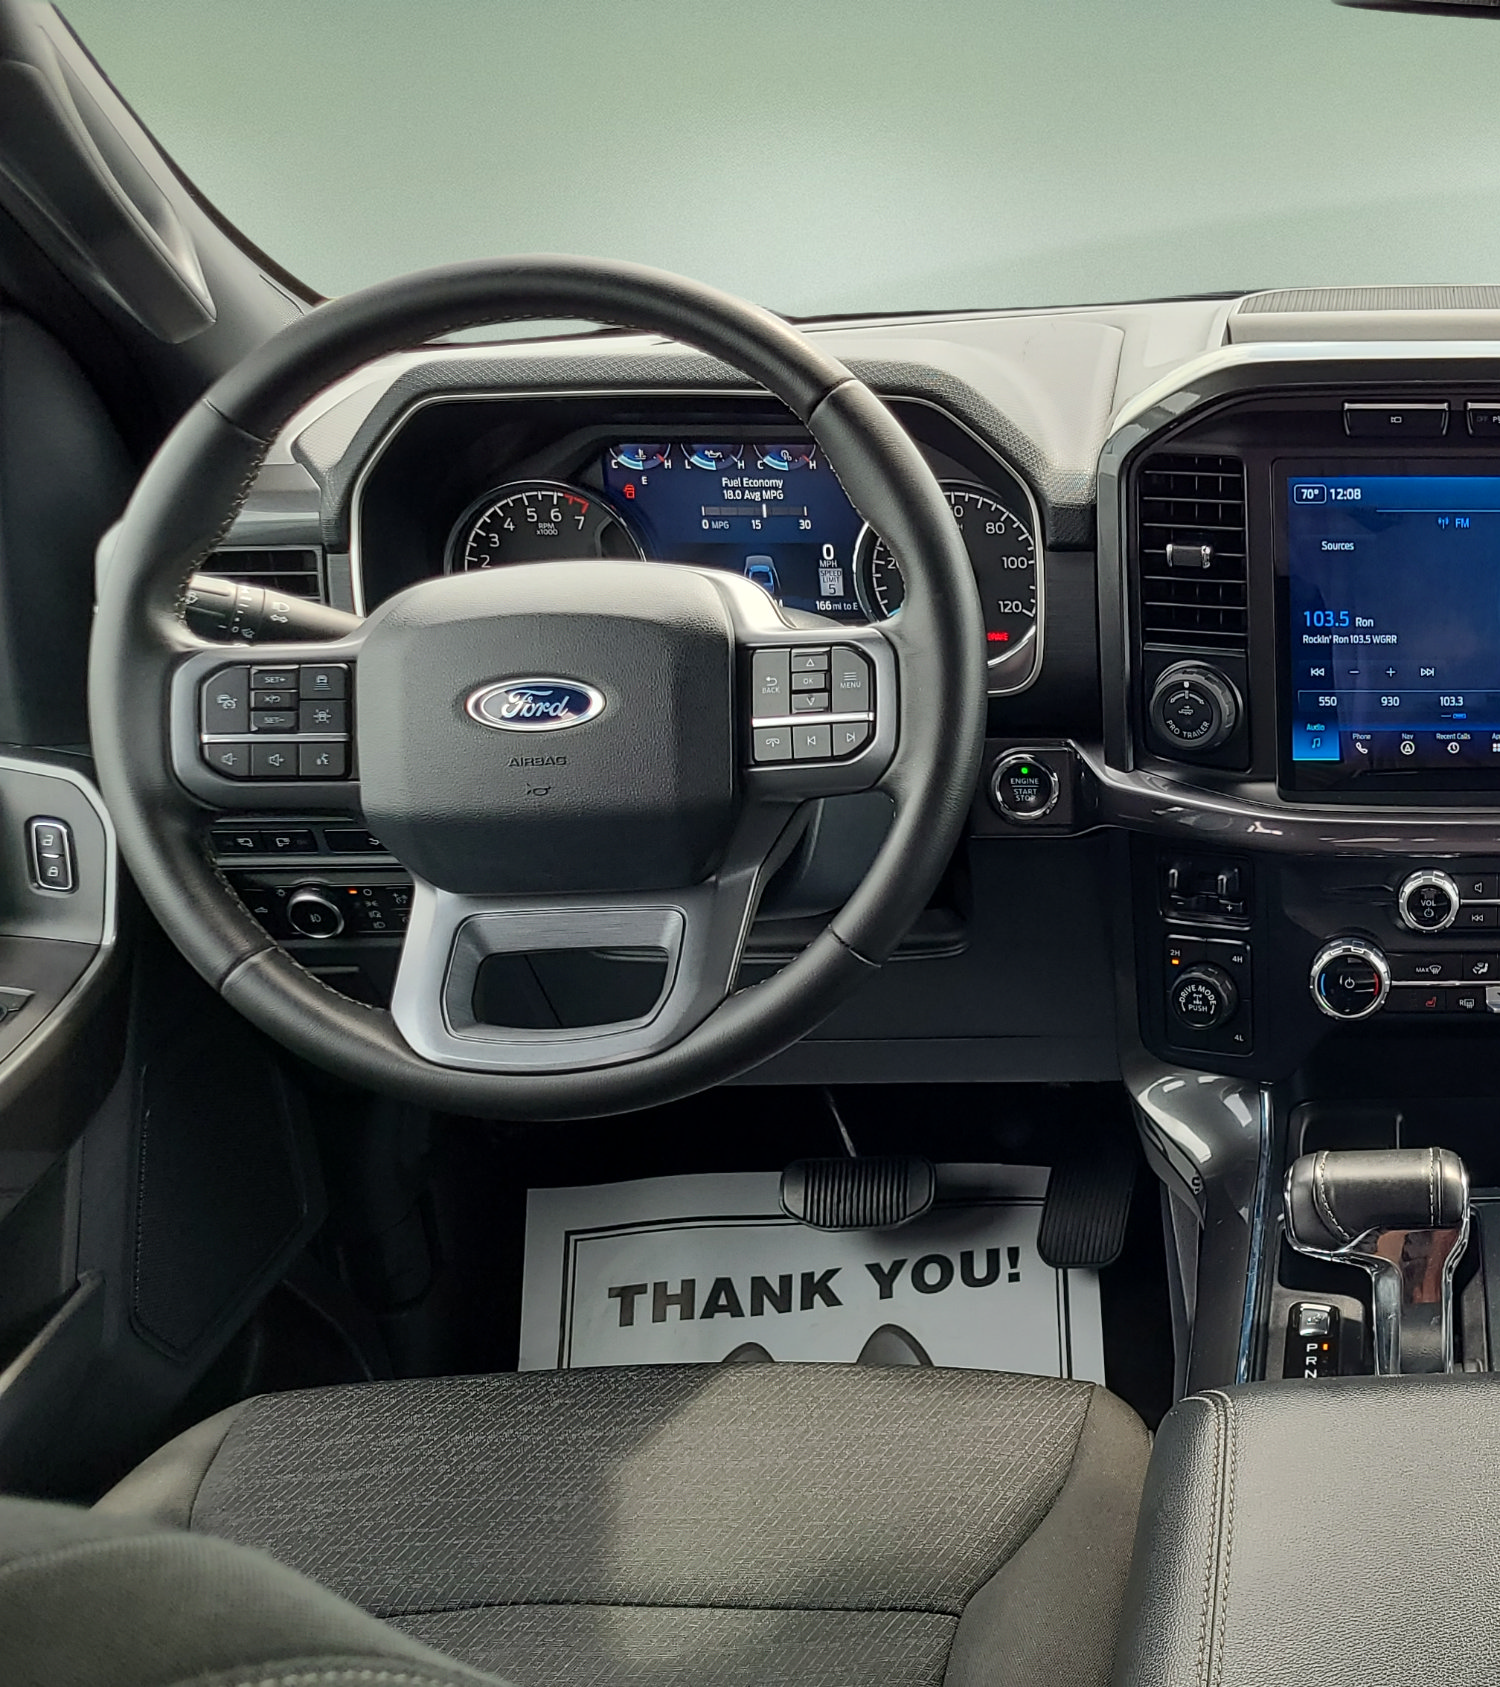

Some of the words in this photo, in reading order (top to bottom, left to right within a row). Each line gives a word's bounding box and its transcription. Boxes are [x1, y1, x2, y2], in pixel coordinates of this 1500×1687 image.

[611, 460, 618, 469] C
[664, 459, 672, 469] H
[685, 459, 691, 469] L
[737, 459, 745, 469] H
[757, 460, 764, 469] C
[809, 459, 817, 469] H
[641, 476, 648, 485] E
[722, 477, 741, 488] Fuel
[743, 477, 784, 490] Economy
[723, 490, 742, 500] 18.0
[743, 490, 762, 502] Avg
[762, 490, 784, 500] MPG
[1329, 488, 1361, 500] 12:08
[526, 508, 538, 522] 5
[550, 508, 562, 522] 6
[503, 517, 515, 531] 4
[574, 516, 585, 530] 7
[702, 520, 709, 530] 0
[711, 520, 730, 530] MPG
[752, 520, 762, 530] 15
[799, 520, 812, 530] 30
[985, 522, 1005, 534] 80
[1455, 518, 1470, 528] FM
[536, 528, 558, 536] x1000
[489, 533, 500, 548] 3
[1321, 541, 1355, 551] Sources
[822, 544, 835, 560] 0
[480, 555, 492, 568] 2
[819, 560, 838, 568] MPH
[1002, 556, 1028, 569] 100
[820, 569, 842, 577] SPEED
[828, 584, 837, 595] 5
[815, 601, 832, 611] 166
[843, 601, 852, 611] to
[852, 602, 858, 610] E
[998, 600, 1022, 613] 120
[1303, 610, 1350, 627] 103.5
[1355, 617, 1374, 627] Ron
[1302, 634, 1332, 644] Rockin'
[1333, 634, 1349, 644] Ron
[1350, 634, 1371, 644] 103.5
[1372, 634, 1398, 644] WGRR
[803, 677, 814, 685] OK
[839, 681, 862, 689] MENU
[762, 686, 780, 694] BACK
[501, 689, 569, 719] Ford
[1318, 696, 1337, 707] 550
[1381, 696, 1400, 707] 930
[1439, 696, 1464, 707] 103.3
[1166, 719, 1180, 735] PRO
[1182, 721, 1210, 739] TRAILER
[1306, 723, 1325, 731] Audio
[1352, 732, 1371, 740] Phone
[1435, 732, 1456, 740] Recent
[1456, 732, 1471, 740] Calls
[507, 756, 568, 768] AIRBAG
[1010, 777, 1040, 785] ENGINE
[1015, 794, 1036, 802] STOP
[1170, 949, 1181, 957] 2H
[1179, 984, 1197, 1003] DRIVE
[1197, 985, 1217, 1005] MODE
[1188, 1003, 1208, 1012] PUSH
[1234, 1034, 1244, 1042] 4L
[608, 1268, 843, 1328] THANK
[865, 1246, 1021, 1301] YOU!
[1306, 1343, 1318, 1352] P
[1305, 1356, 1318, 1365] R
[1304, 1369, 1318, 1379] N
